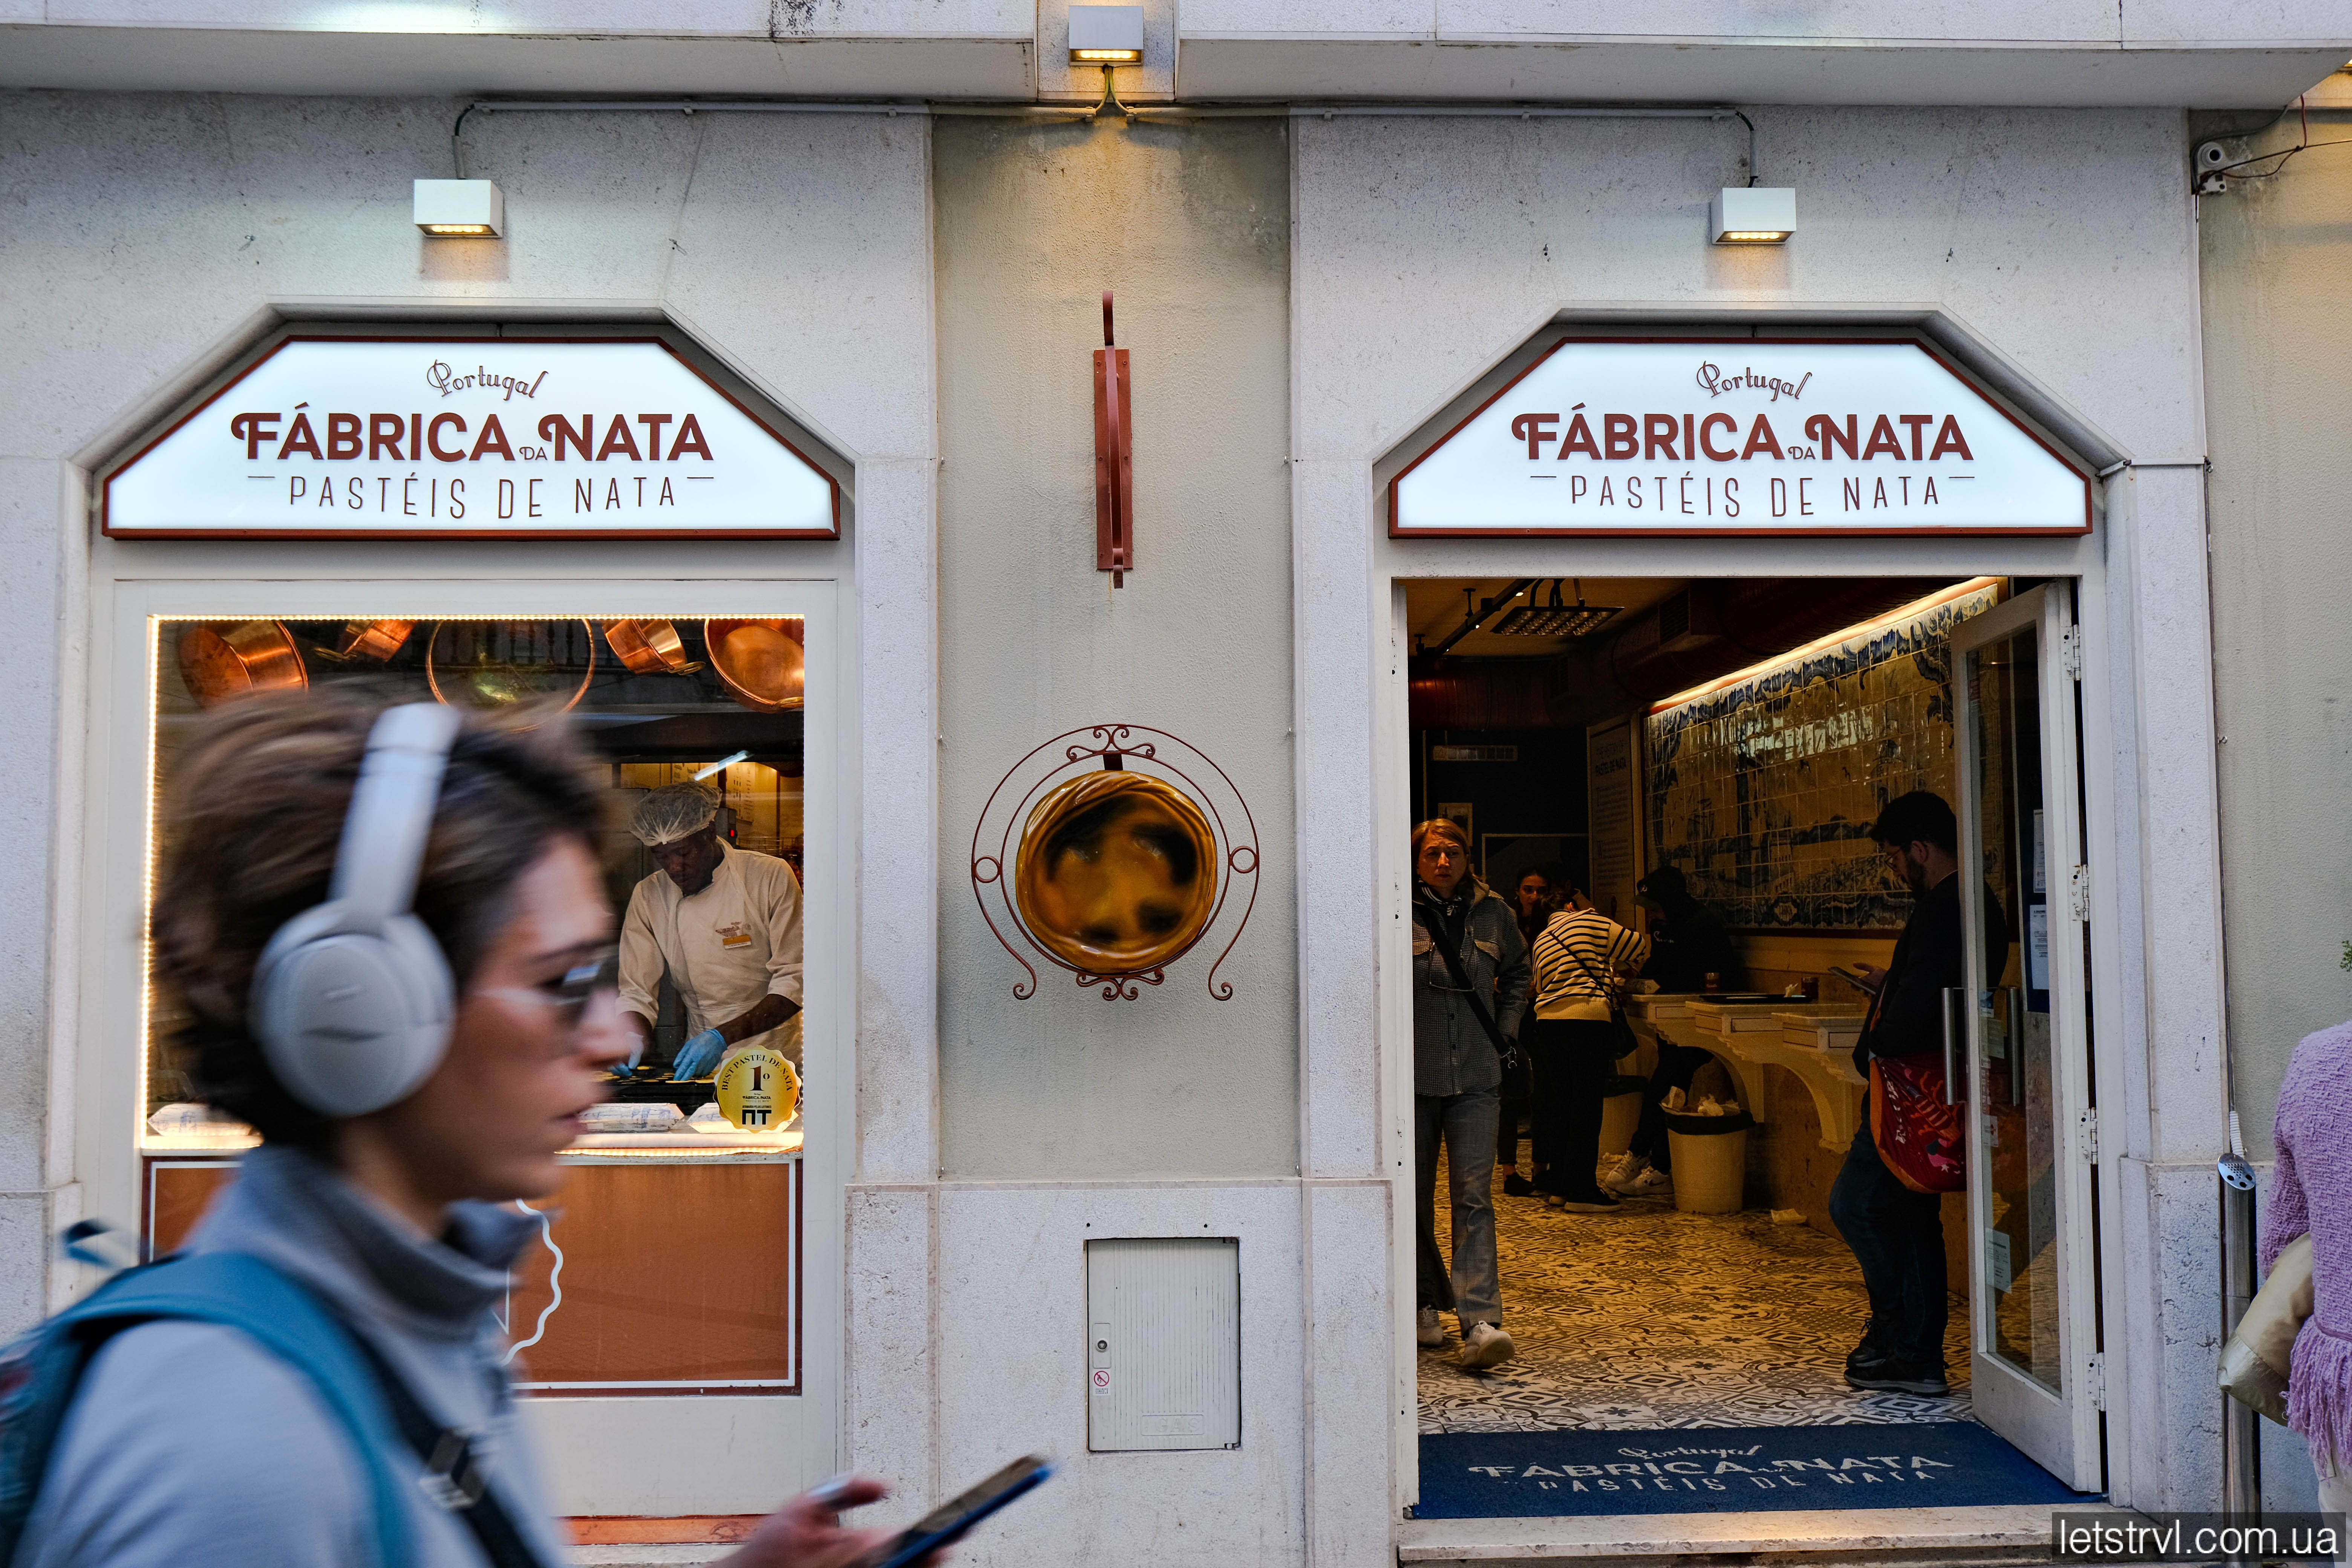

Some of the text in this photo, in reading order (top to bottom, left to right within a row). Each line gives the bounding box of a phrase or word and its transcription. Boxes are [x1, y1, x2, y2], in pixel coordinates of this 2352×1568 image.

[426, 359, 549, 401] Portugal
[1696, 360, 1813, 402] Portugal
[231, 401, 714, 462] FÁBRICA DA NATA
[1511, 402, 1974, 462] FÁBRICA DA NATA
[290, 472, 674, 519] PASTÉIS DE NATA
[1571, 471, 1939, 518] PASTÉIS DE NATA
[721, 1055, 793, 1091] BEST PASTEL DE NATA
[1156, 1418, 1200, 1433] GAS
[1750, 1475, 1806, 1488] DE
[1827, 1471, 1936, 1484] NATA
[1771, 1456, 1954, 1470] NATA
